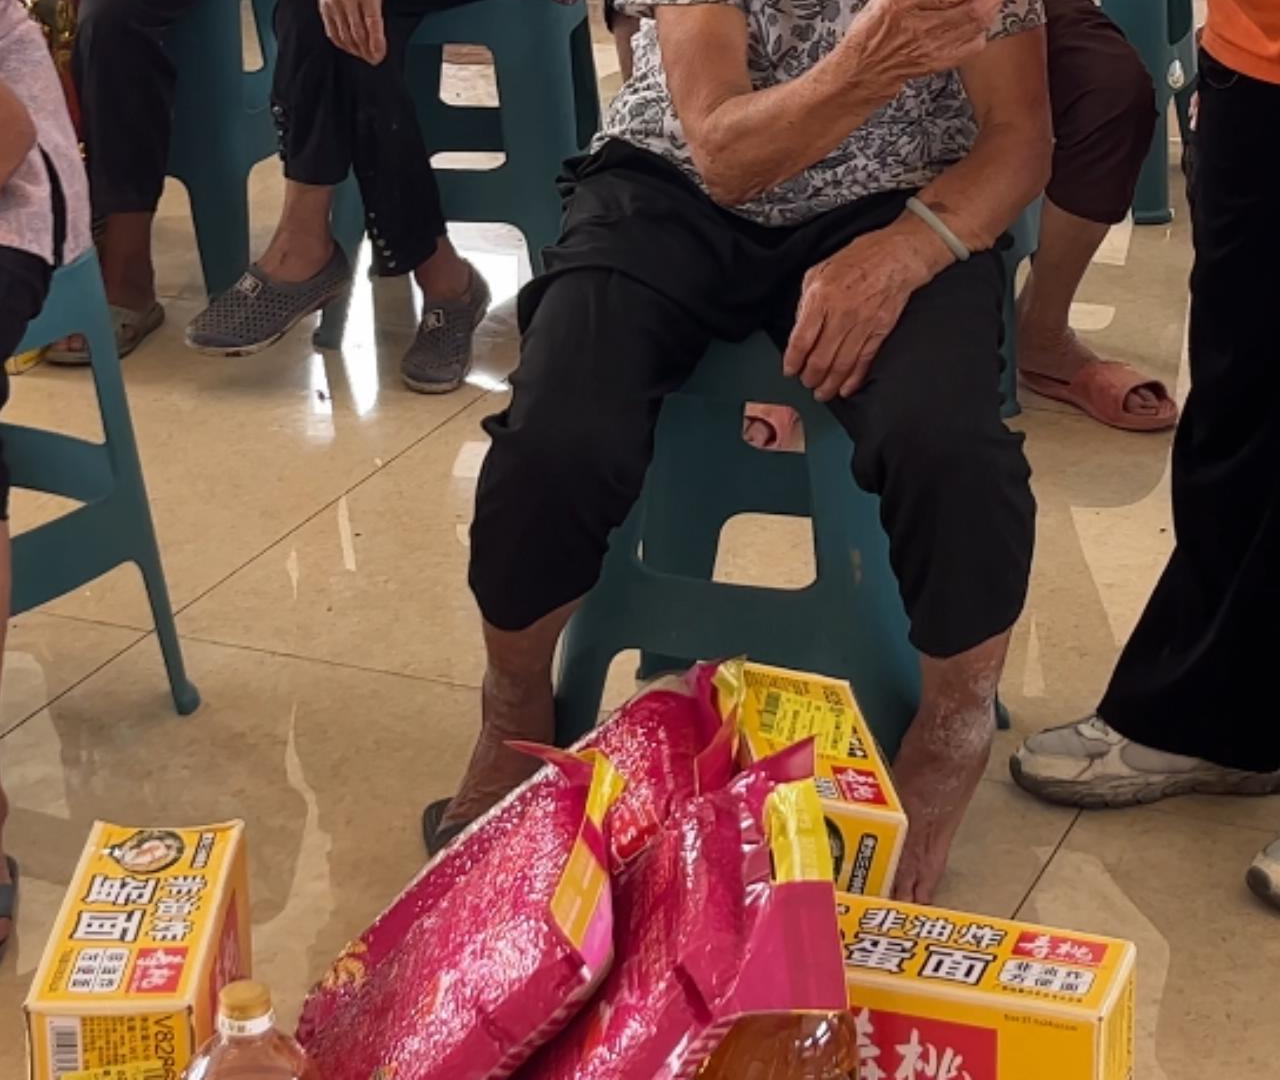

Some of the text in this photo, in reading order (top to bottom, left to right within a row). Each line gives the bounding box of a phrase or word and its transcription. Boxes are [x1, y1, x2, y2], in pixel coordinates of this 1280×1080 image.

[69, 874, 160, 943] 蛋面
[146, 874, 207, 942] 非油炸
[860, 906, 1007, 951] 非油炸
[844, 931, 996, 986] 蛋面
[1018, 934, 1094, 963] 寿桃
